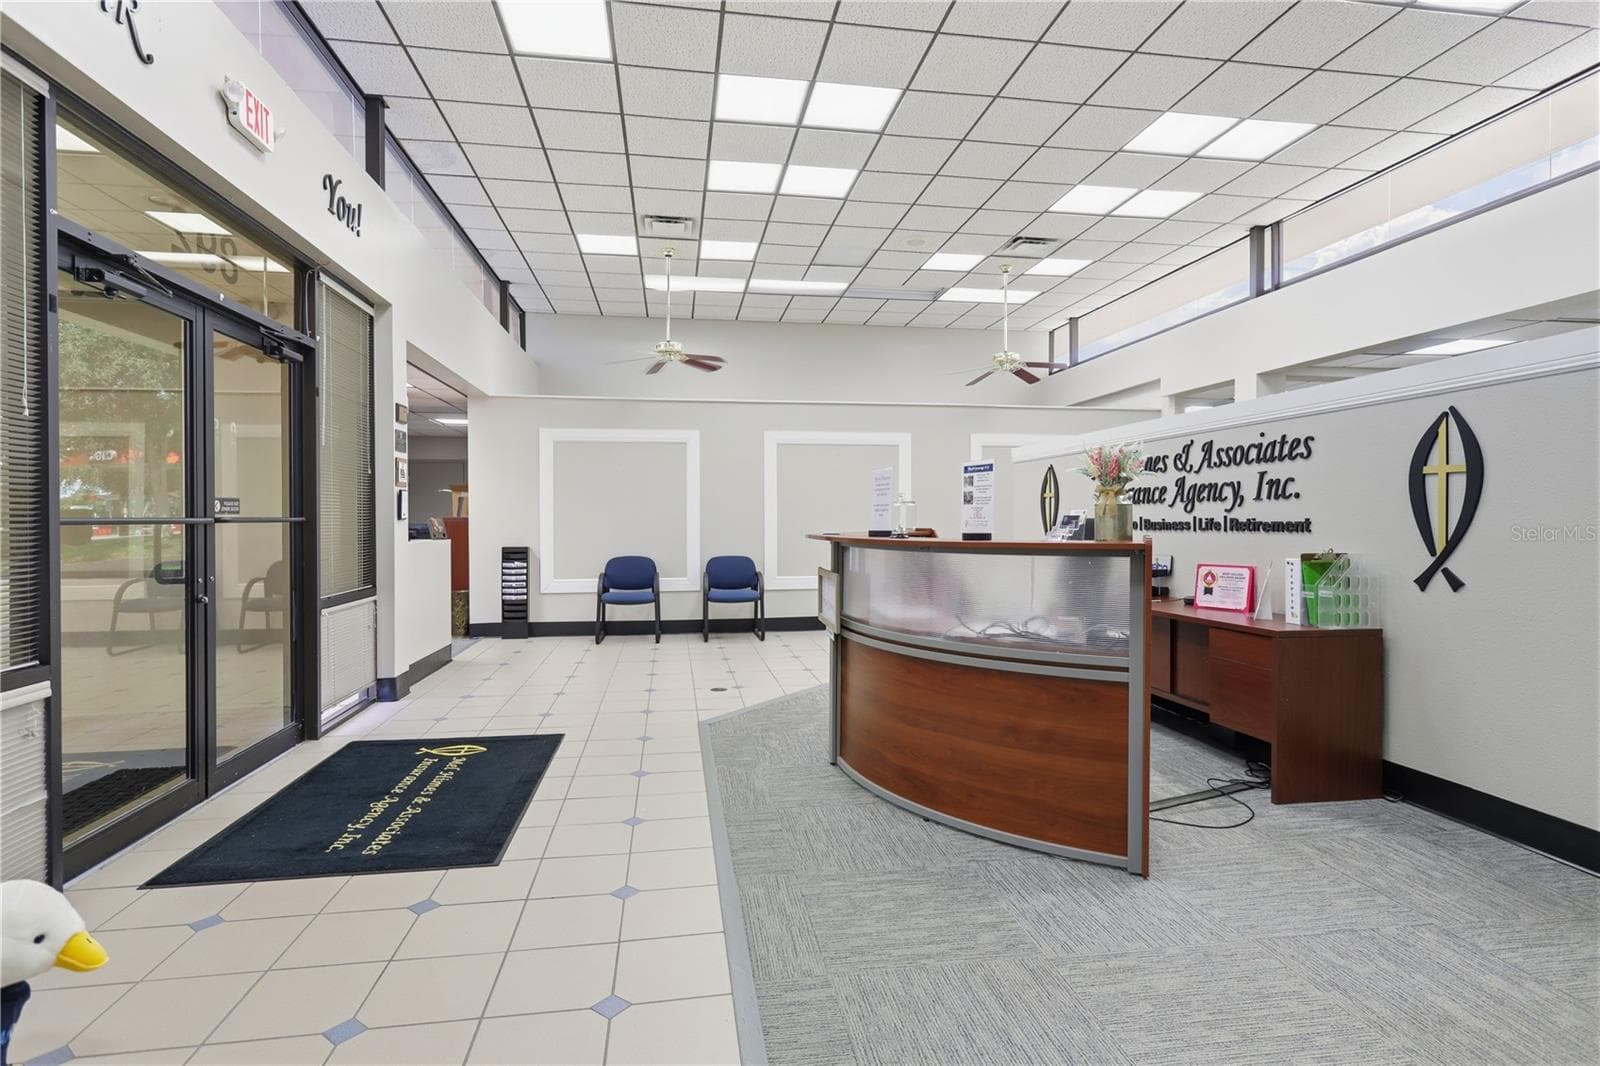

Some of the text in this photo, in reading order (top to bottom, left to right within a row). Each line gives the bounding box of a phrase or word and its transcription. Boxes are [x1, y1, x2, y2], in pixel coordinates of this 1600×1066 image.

[244, 88, 270, 145] EXIT
[323, 174, 362, 237] You!
[1173, 439, 1195, 473] &
[1194, 432, 1315, 474] Associates
[1127, 470, 1300, 513] rance Agency, Inc.
[325, 757, 439, 853] Insurance Agency, Inc.
[362, 805, 421, 855] Associates
